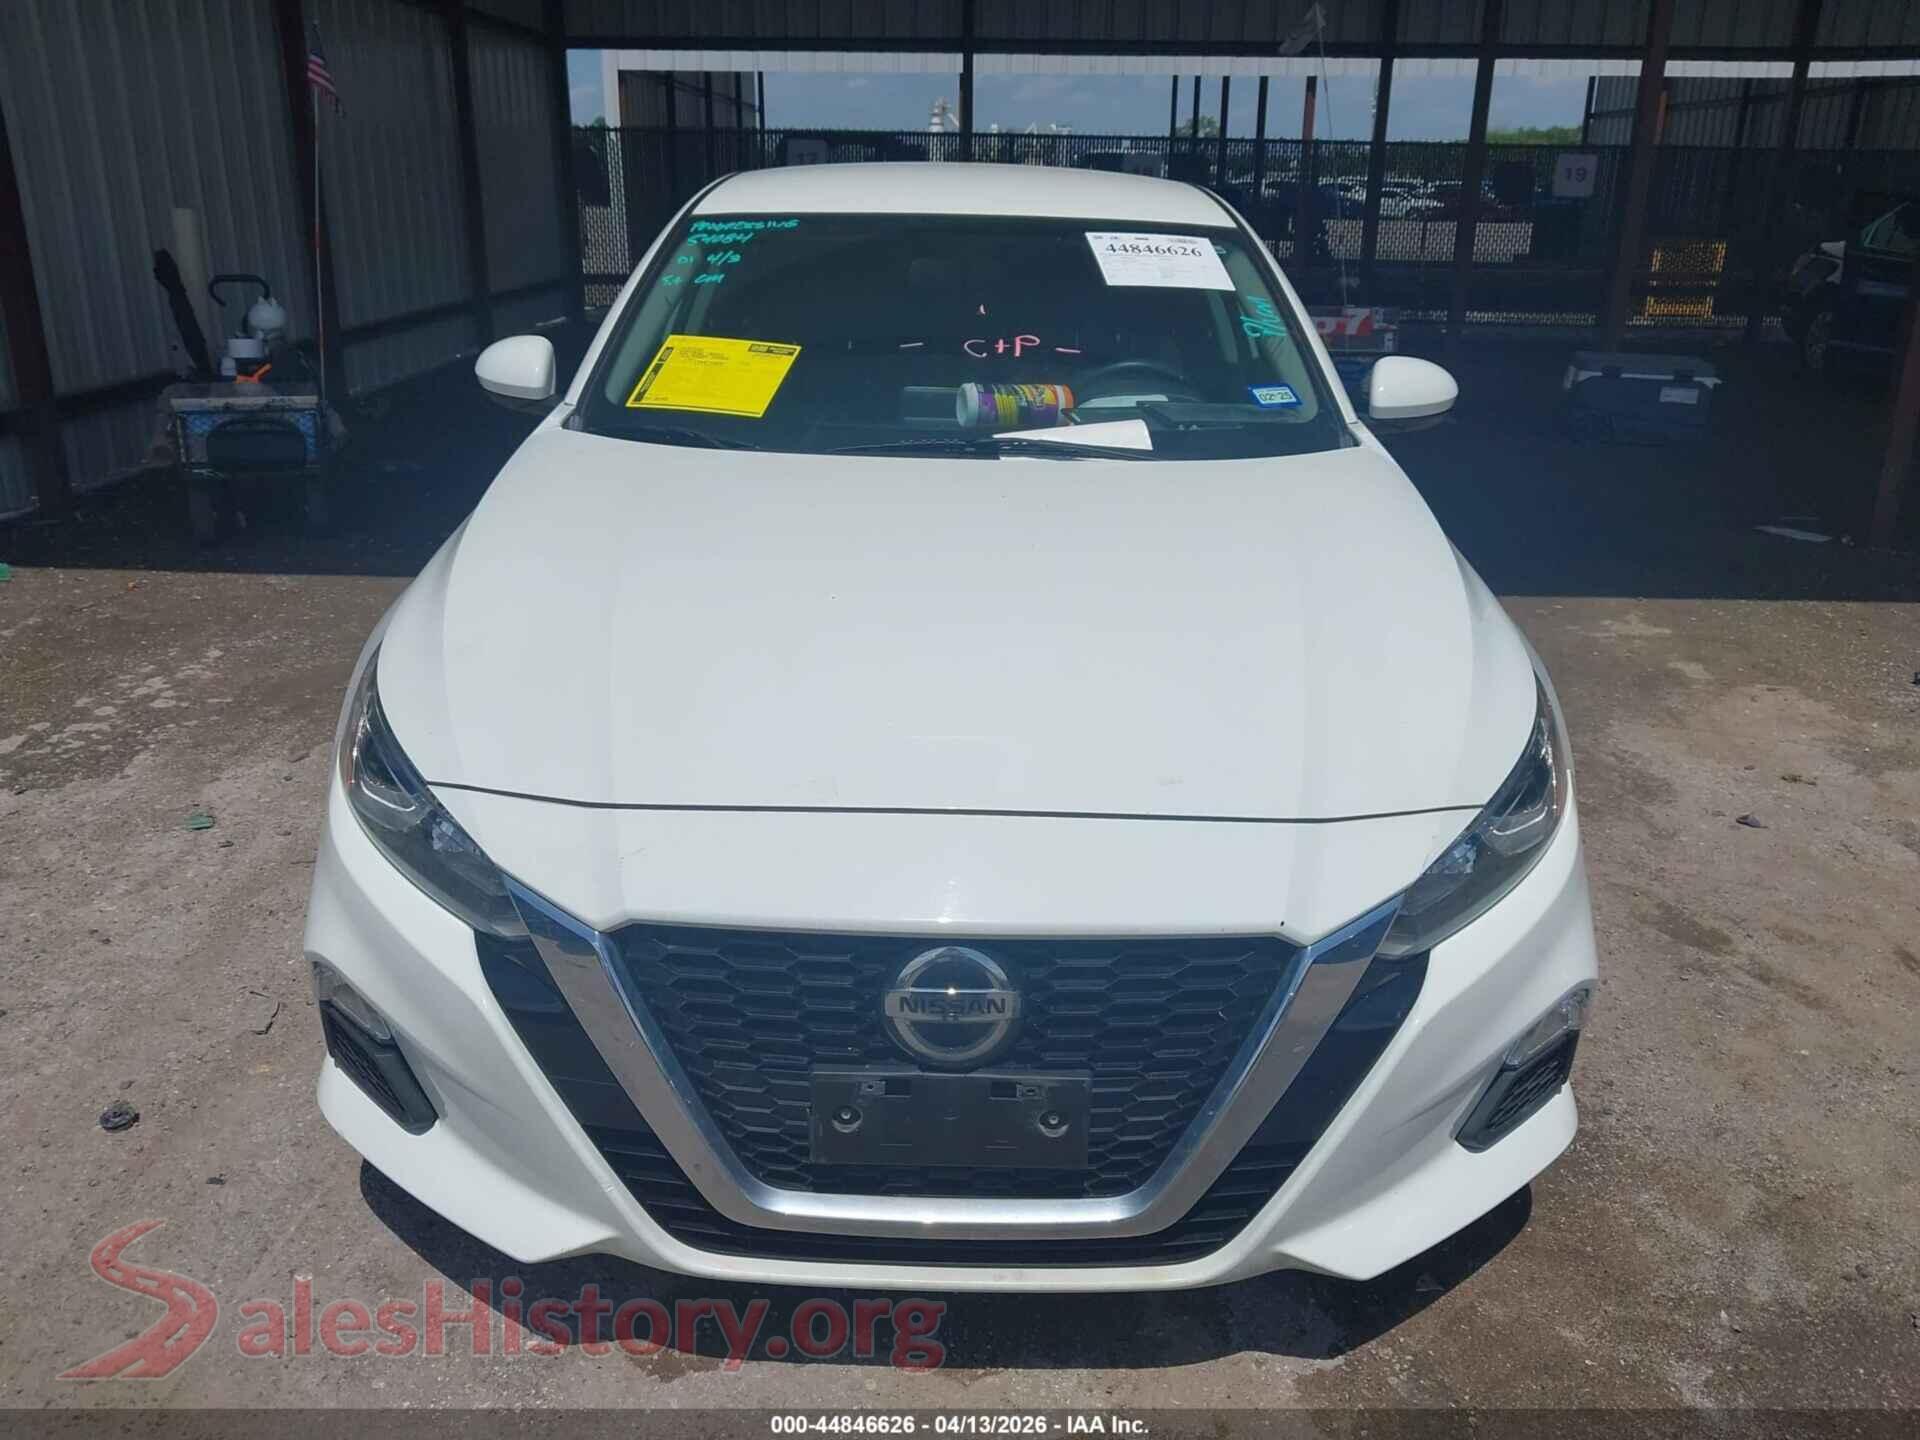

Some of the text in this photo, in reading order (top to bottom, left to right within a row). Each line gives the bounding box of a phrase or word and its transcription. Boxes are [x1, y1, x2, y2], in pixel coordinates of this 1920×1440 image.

[1564, 167, 1587, 183] 19
[1105, 242, 1203, 257] 44846626
[899, 996, 1007, 1015] NISSAN
